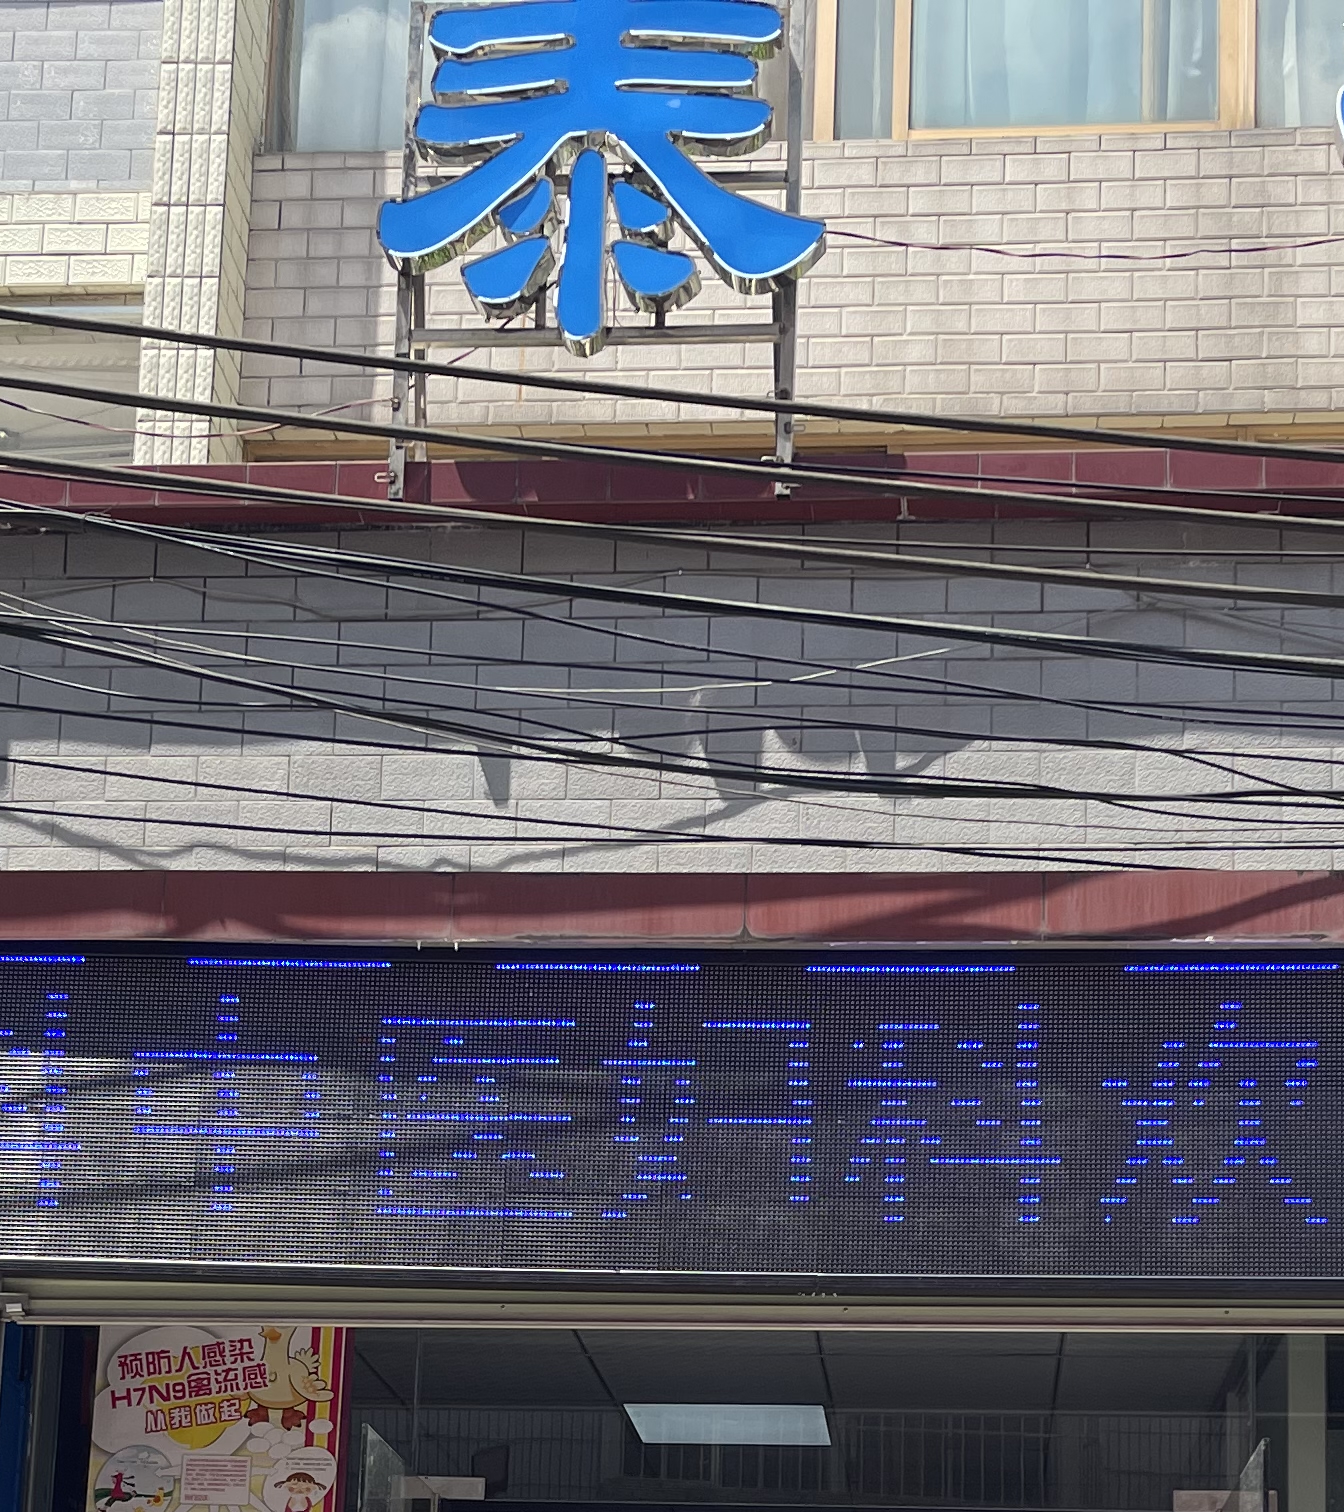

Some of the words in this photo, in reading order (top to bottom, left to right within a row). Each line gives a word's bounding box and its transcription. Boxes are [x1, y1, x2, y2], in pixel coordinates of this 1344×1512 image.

[117, 1338, 256, 1381] 预防人感染
[110, 1363, 269, 1409] H7N9禽流感
[145, 1400, 243, 1434] 从我做起
